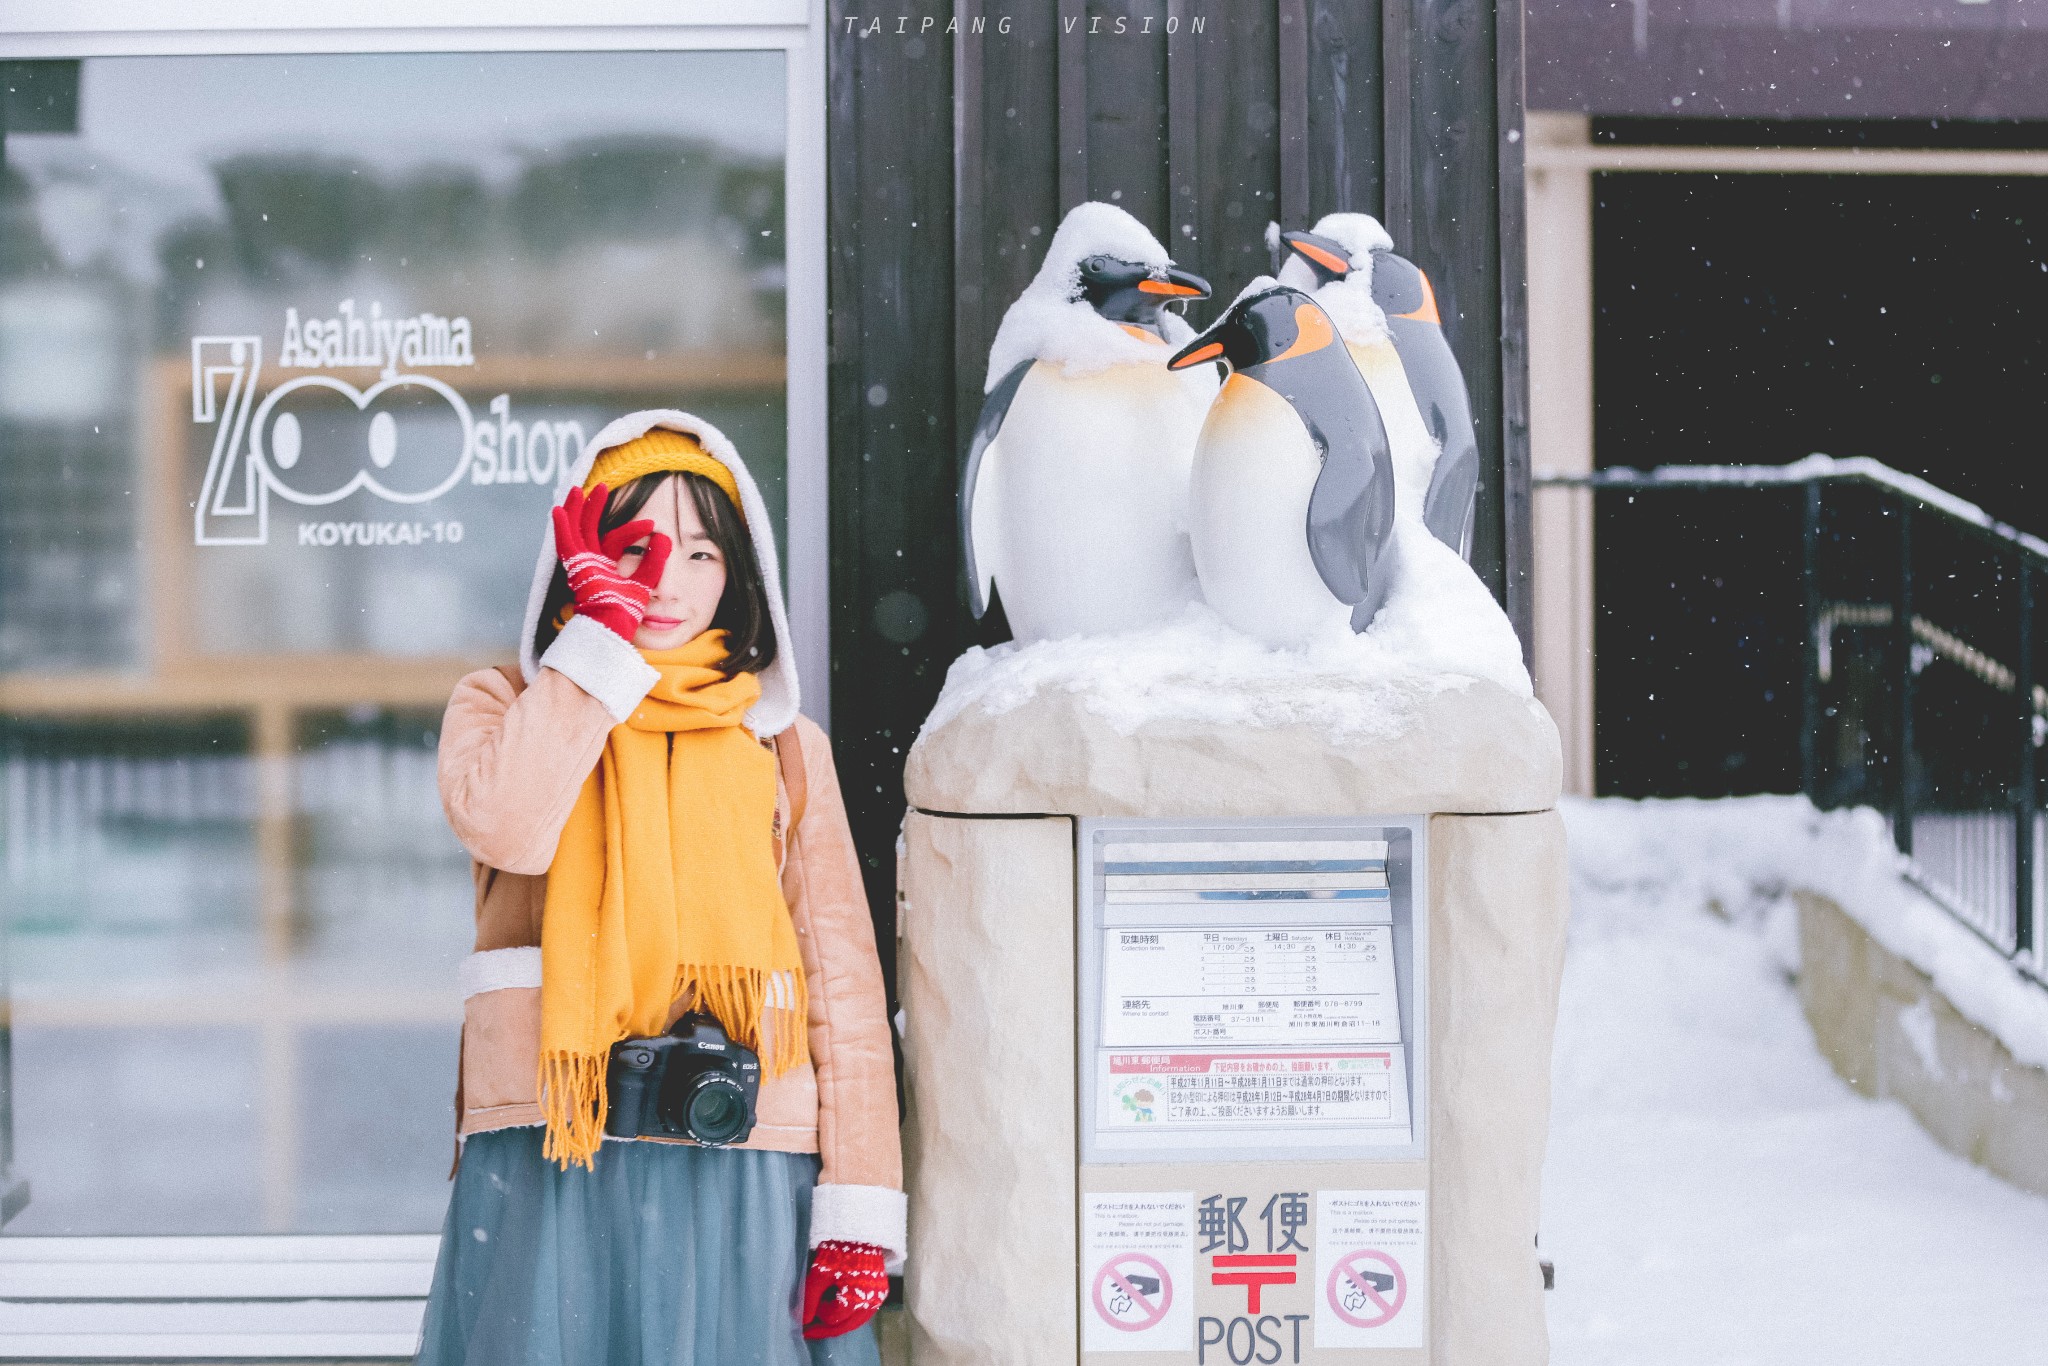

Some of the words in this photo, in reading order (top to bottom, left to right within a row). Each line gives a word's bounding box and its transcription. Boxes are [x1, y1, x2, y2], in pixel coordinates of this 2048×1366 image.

[278, 298, 475, 382] Asahiyama
[298, 521, 464, 547] KOYUKAI-10
[1120, 935, 1159, 944] 取集時刻
[1203, 933, 1220, 942] 平日
[1264, 932, 1289, 942] 土曜日
[1325, 932, 1341, 941] 休日
[1122, 1000, 1151, 1010] 連絡先
[697, 1041, 726, 1051] Canon
[1149, 1064, 1202, 1073] Information
[1197, 1192, 1310, 1254] 郵便
[1198, 1314, 1310, 1366] POST
